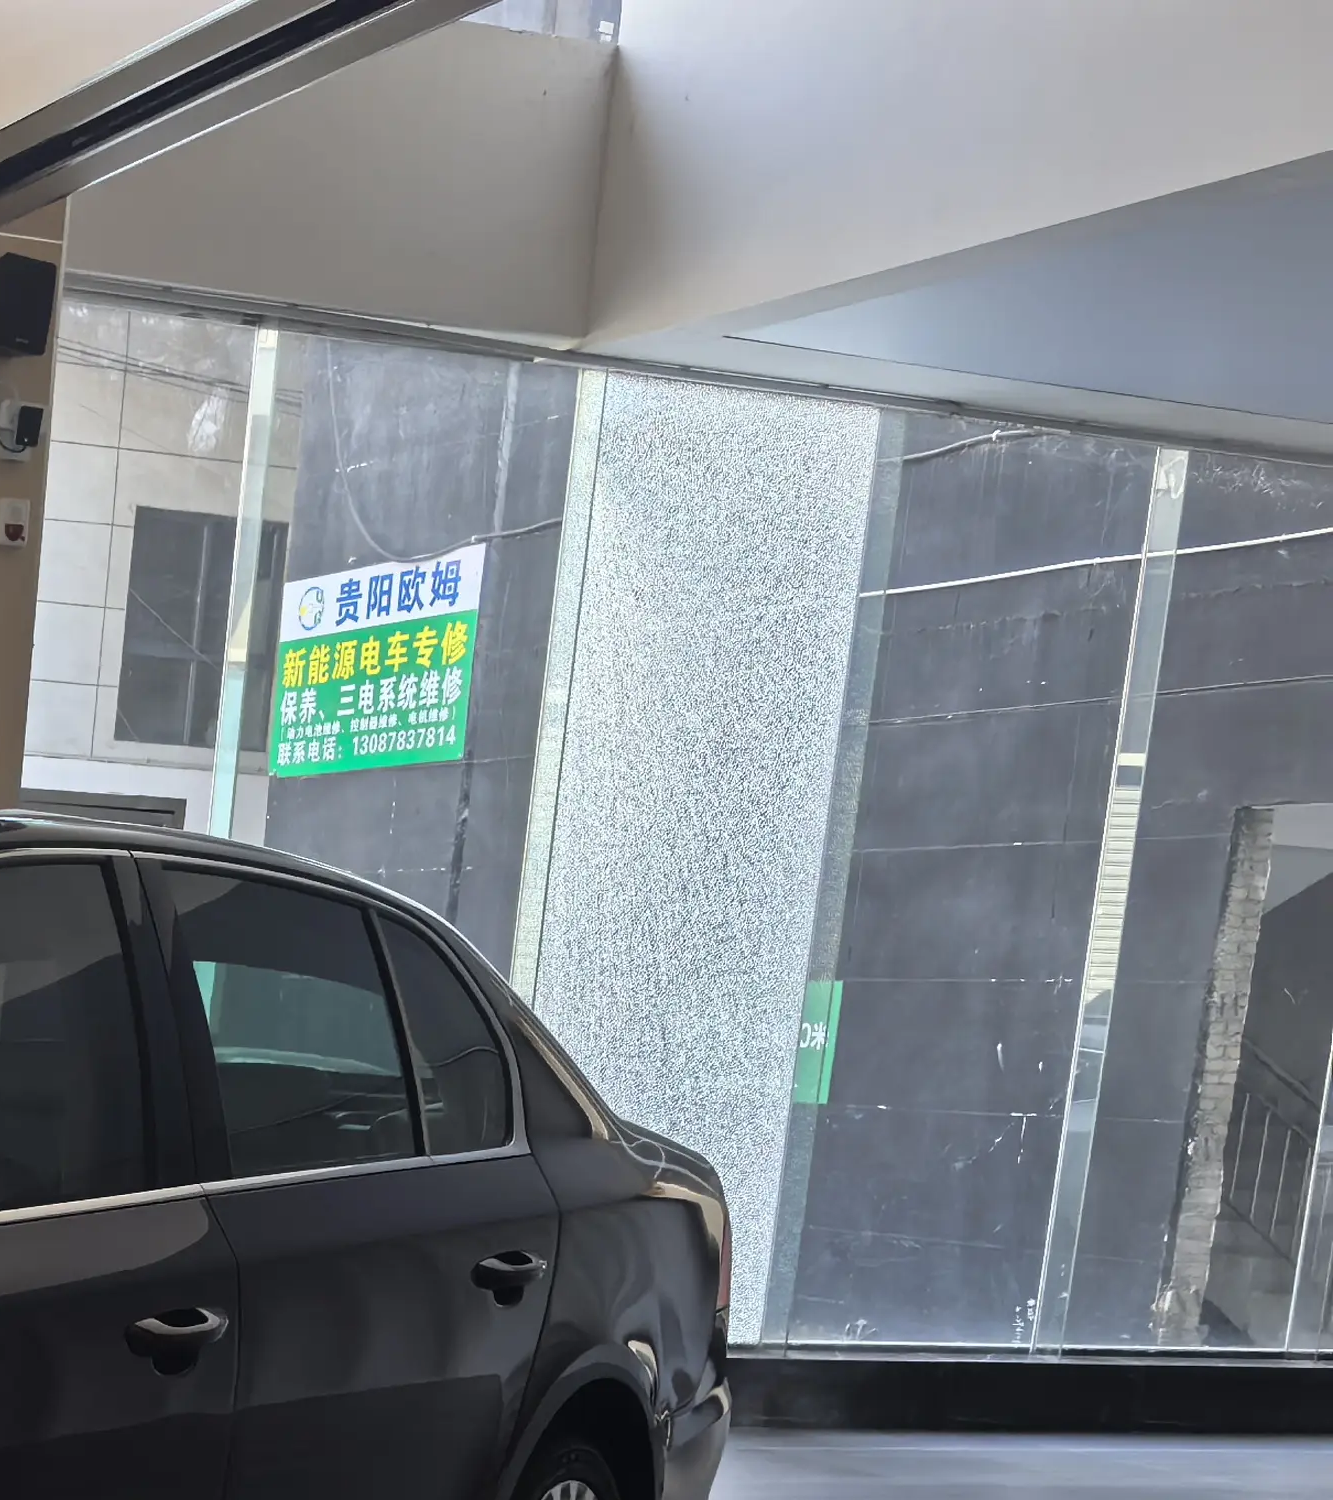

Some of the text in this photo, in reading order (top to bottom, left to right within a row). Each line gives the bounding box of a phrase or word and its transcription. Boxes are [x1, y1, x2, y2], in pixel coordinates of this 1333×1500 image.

[335, 559, 462, 627] 贵阳欧姆
[282, 620, 469, 689] 新能源电车专修
[279, 665, 463, 726] 保养、三电系统维修
[351, 724, 457, 757] 13087837814
